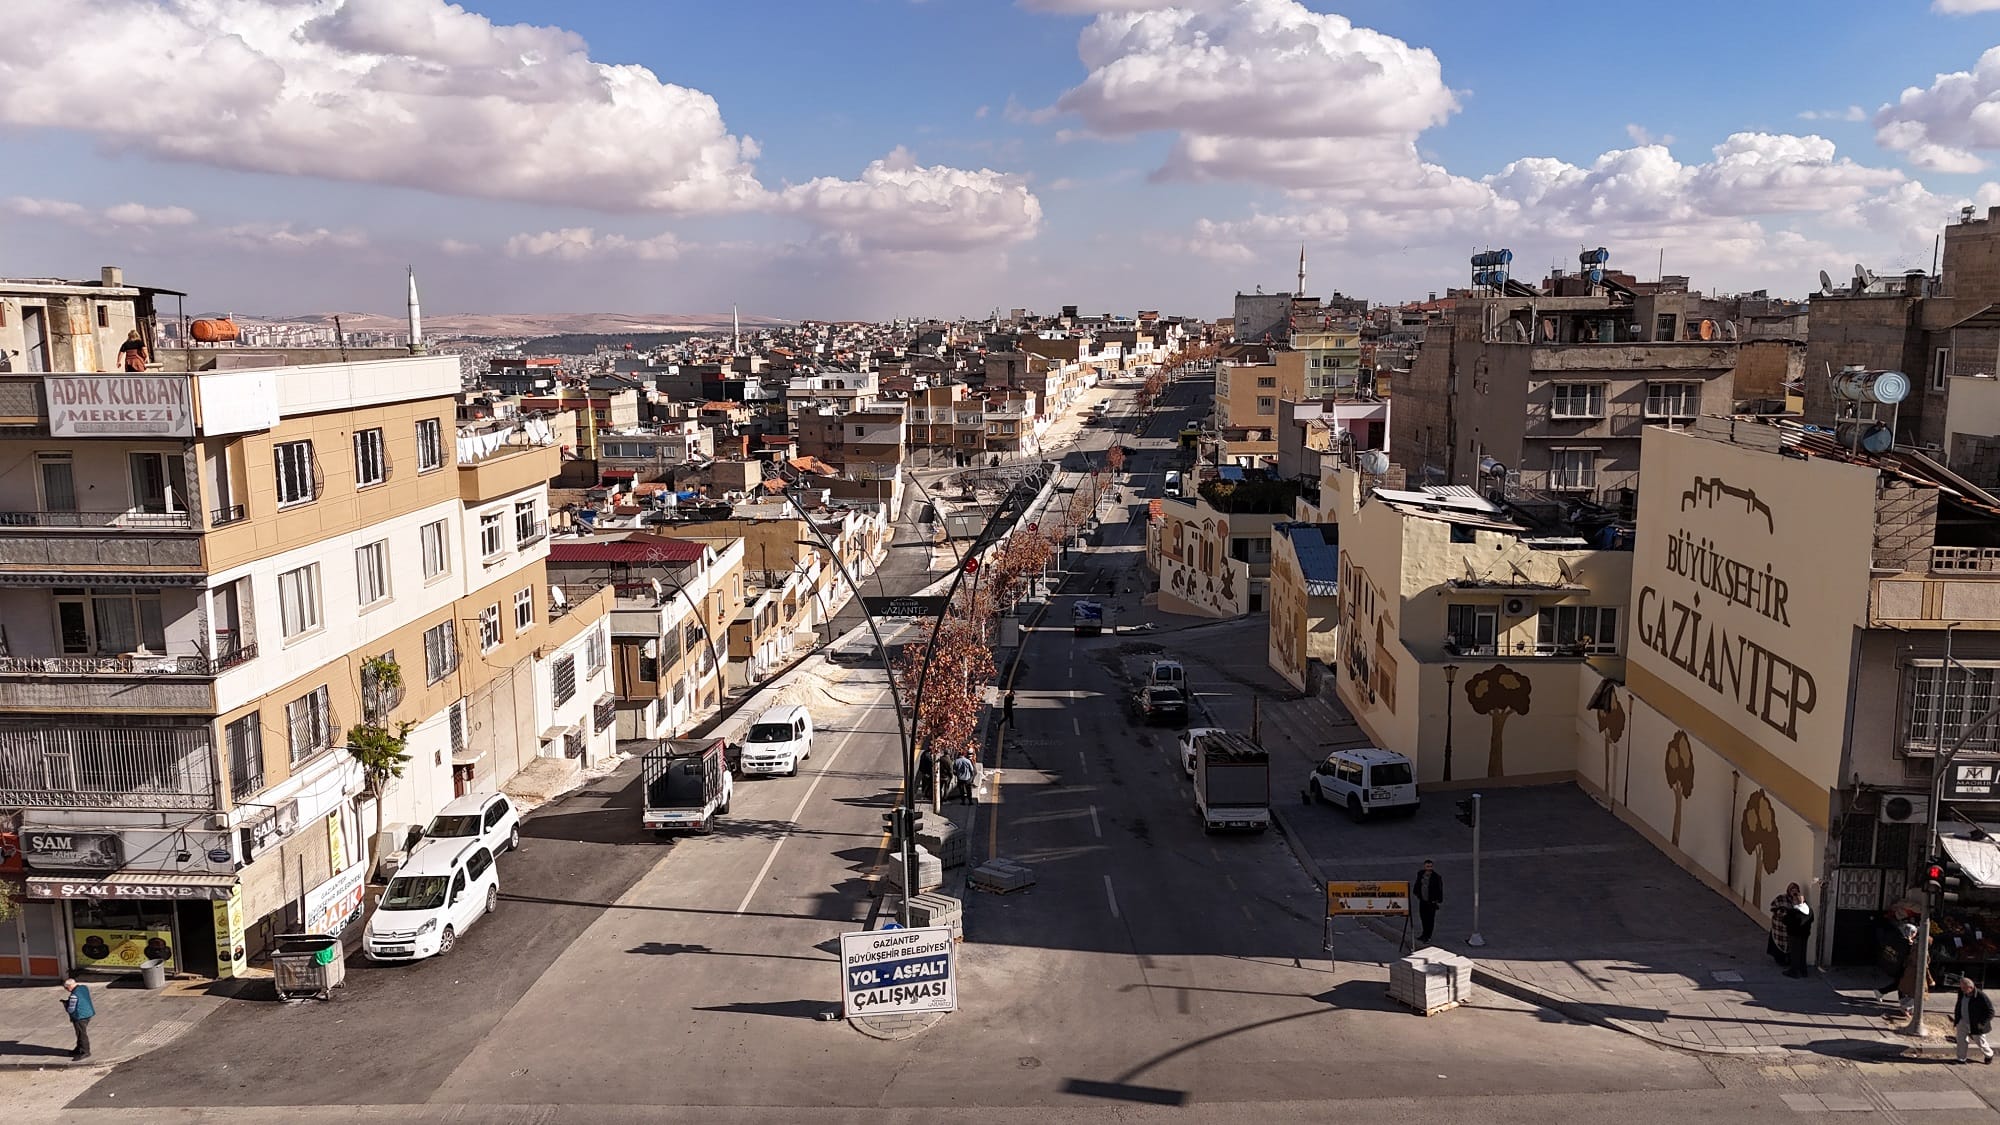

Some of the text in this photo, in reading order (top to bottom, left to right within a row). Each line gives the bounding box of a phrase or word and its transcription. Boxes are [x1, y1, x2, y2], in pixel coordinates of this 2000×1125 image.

[52, 379, 185, 405] ADAK KURBAN
[68, 406, 173, 421] MERKEZİ
[1666, 528, 1791, 628] BÜYÜKŞEHİR
[1638, 585, 1817, 743] GAZİANTEP
[32, 836, 73, 853] ŞAM
[60, 885, 193, 897] ŞAM KAHVE
[848, 942, 947, 965] BÜYÜKŞEHİR BELEDİYESİ
[873, 935, 920, 949] GAZİANTEP
[851, 970, 881, 986] YOL
[892, 960, 947, 980] ASFALT
[853, 982, 947, 1010] ÇALIŞMASI
